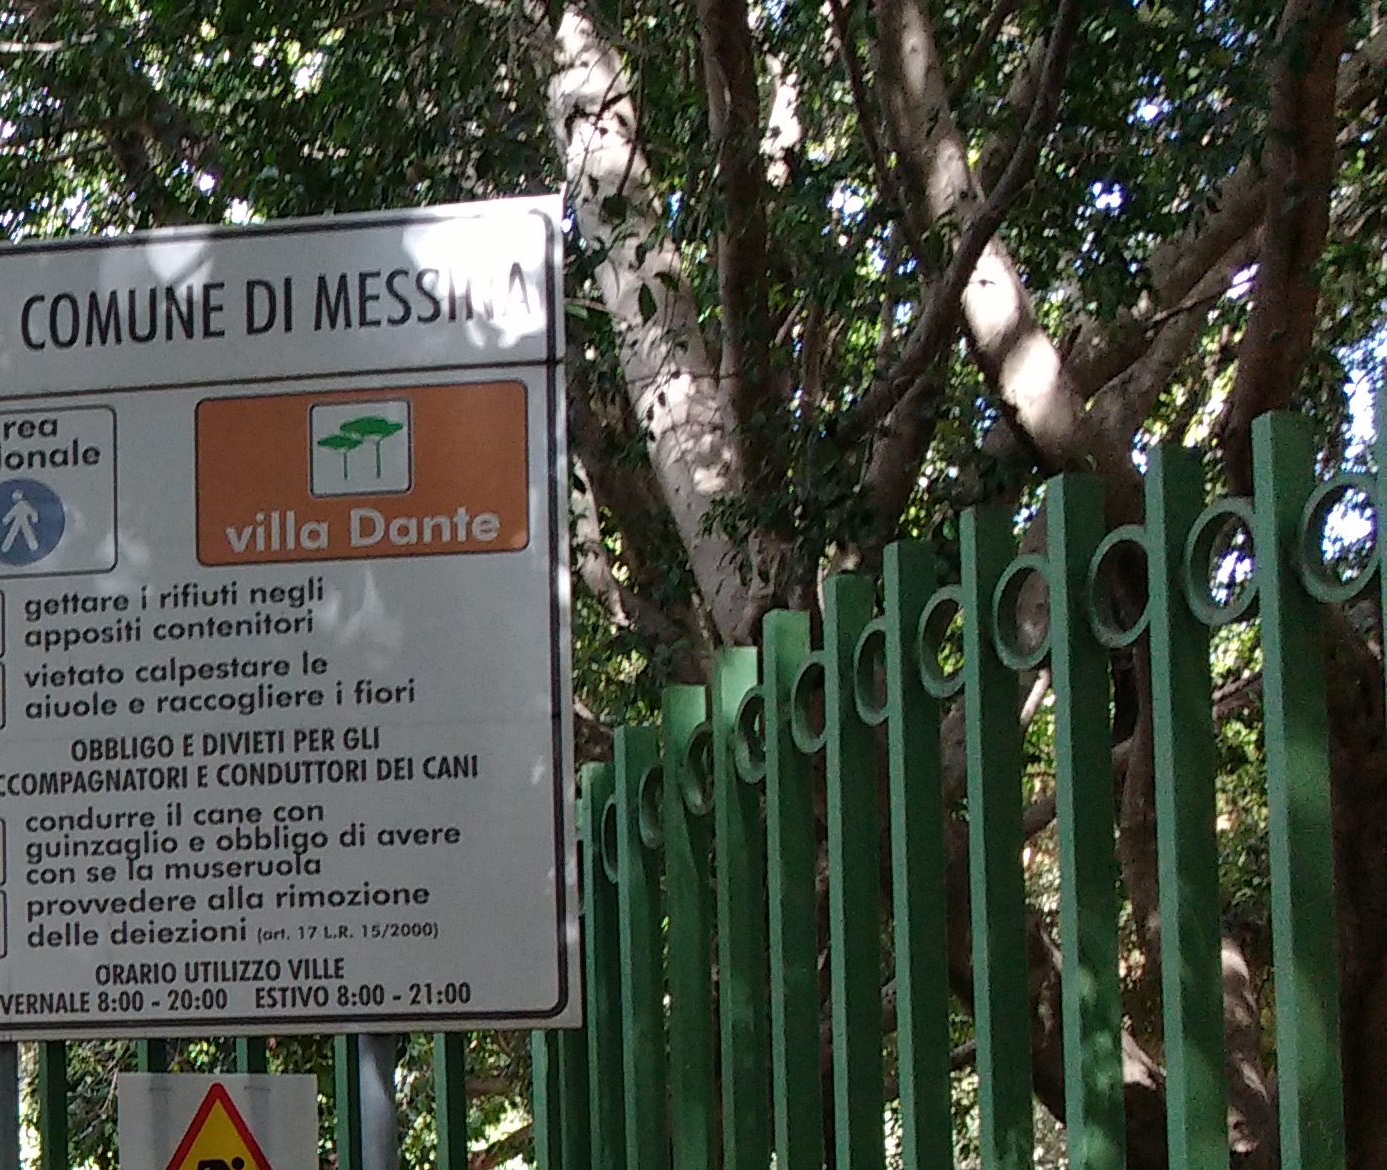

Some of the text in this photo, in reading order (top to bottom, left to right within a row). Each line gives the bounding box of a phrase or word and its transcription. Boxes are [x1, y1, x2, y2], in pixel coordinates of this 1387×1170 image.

[22, 282, 225, 351] COMUNE
[246, 277, 292, 335] DI
[226, 506, 500, 552] villa Dante
[25, 576, 323, 622] gettare i rifiuti negli
[25, 609, 313, 651] appositi contenitori
[24, 651, 328, 688] vietato calpestare le
[26, 678, 414, 719] aiuole e raccogliere i fiori
[71, 726, 379, 761] OBBLIGO E DIVIETI PER GLI
[198, 765, 208, 788] E
[217, 759, 366, 787] CONDUTTORI
[377, 757, 413, 781] DEI
[423, 755, 477, 779] CANI
[26, 802, 323, 832] condurre il cane con
[26, 823, 460, 864] guinzaglio e obbligo di avere
[27, 850, 322, 885] con se la museruola
[27, 882, 430, 922] provvedere alla rimozione
[28, 917, 438, 948] delle deiezioni (art. 17 L.R. 15/2000)
[96, 958, 344, 986] ORARIO UTILIZZO VILLE
[98, 991, 143, 1012] 8:00
[168, 988, 227, 1011] 20:00
[256, 986, 329, 1008] ESTIVO
[338, 984, 384, 1007] 8:00
[409, 982, 470, 1005] 21:00
